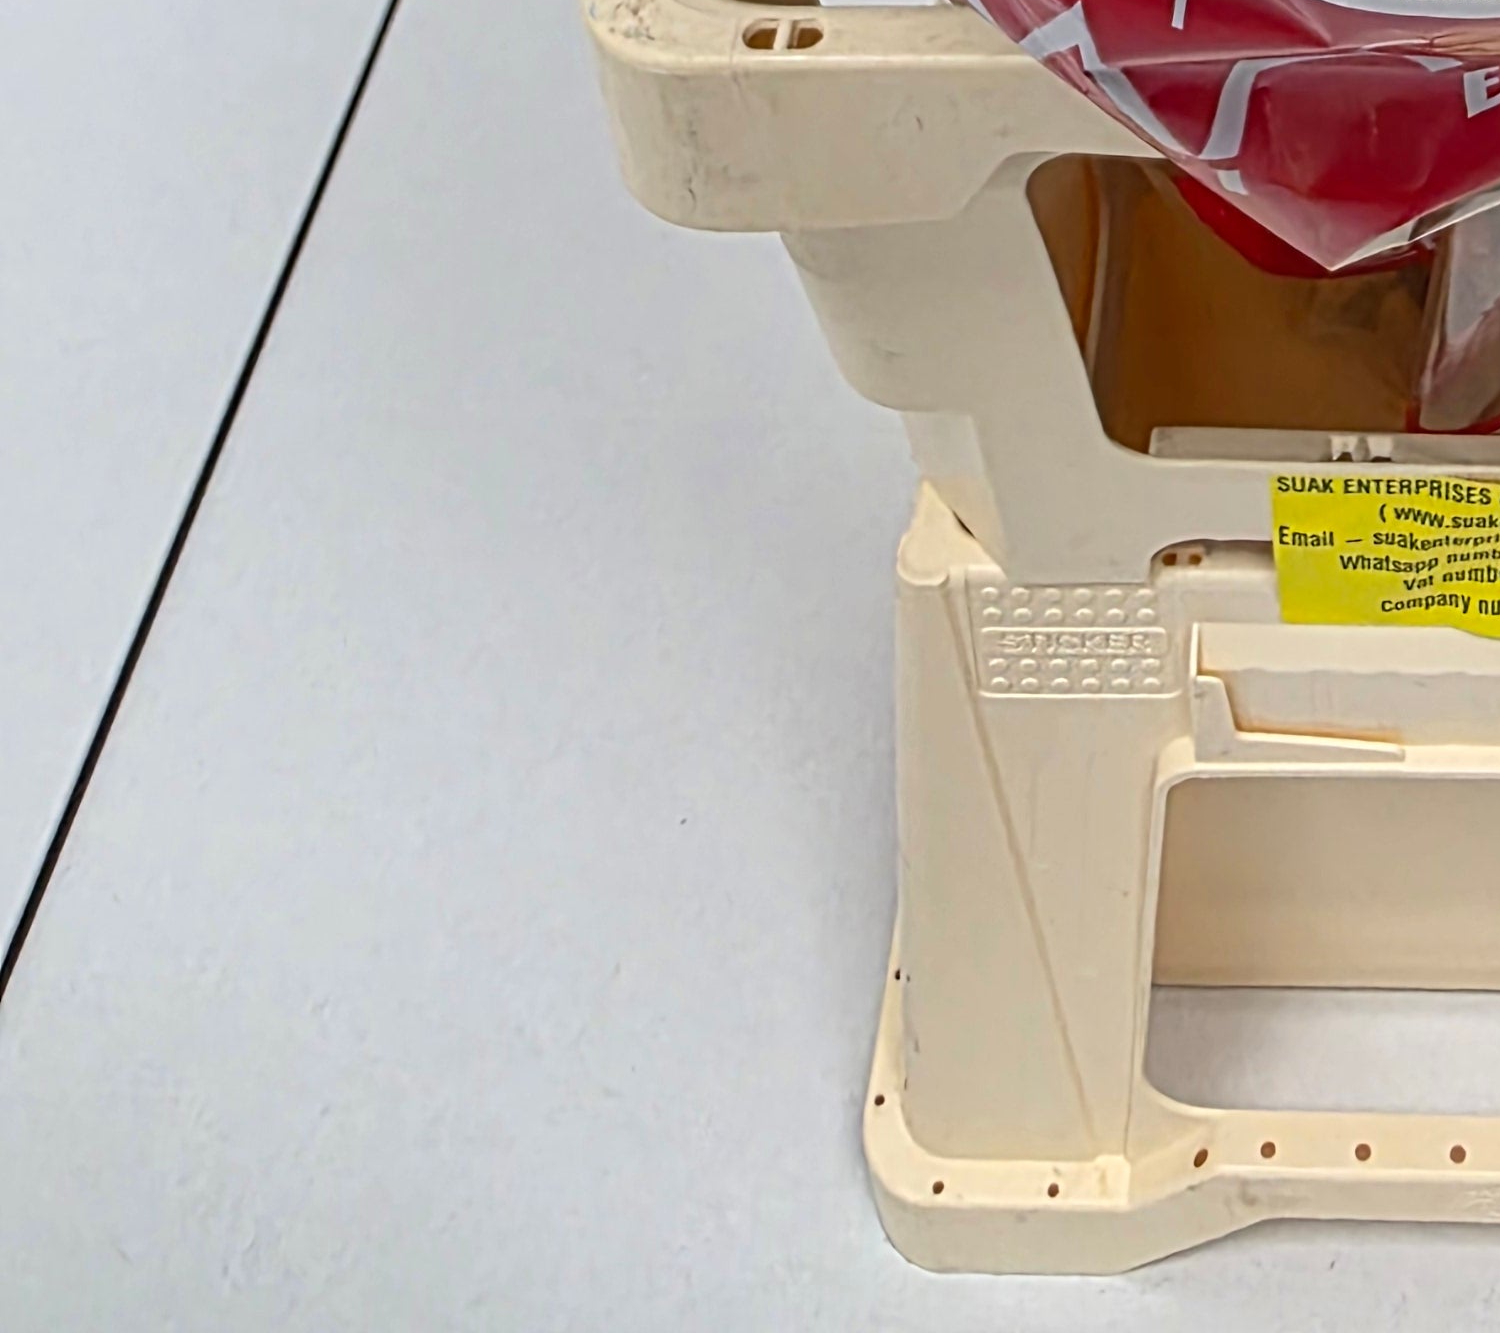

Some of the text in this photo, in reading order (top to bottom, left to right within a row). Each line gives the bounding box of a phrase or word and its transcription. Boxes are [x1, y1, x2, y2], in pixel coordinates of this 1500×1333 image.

[1276, 475, 1334, 495] SUAK
[1343, 479, 1493, 506] ENTERPRISES
[1278, 525, 1335, 548] Email
[1339, 553, 1439, 575] Whatsapp
[1402, 575, 1435, 592] Vat
[1380, 591, 1472, 615] Company
